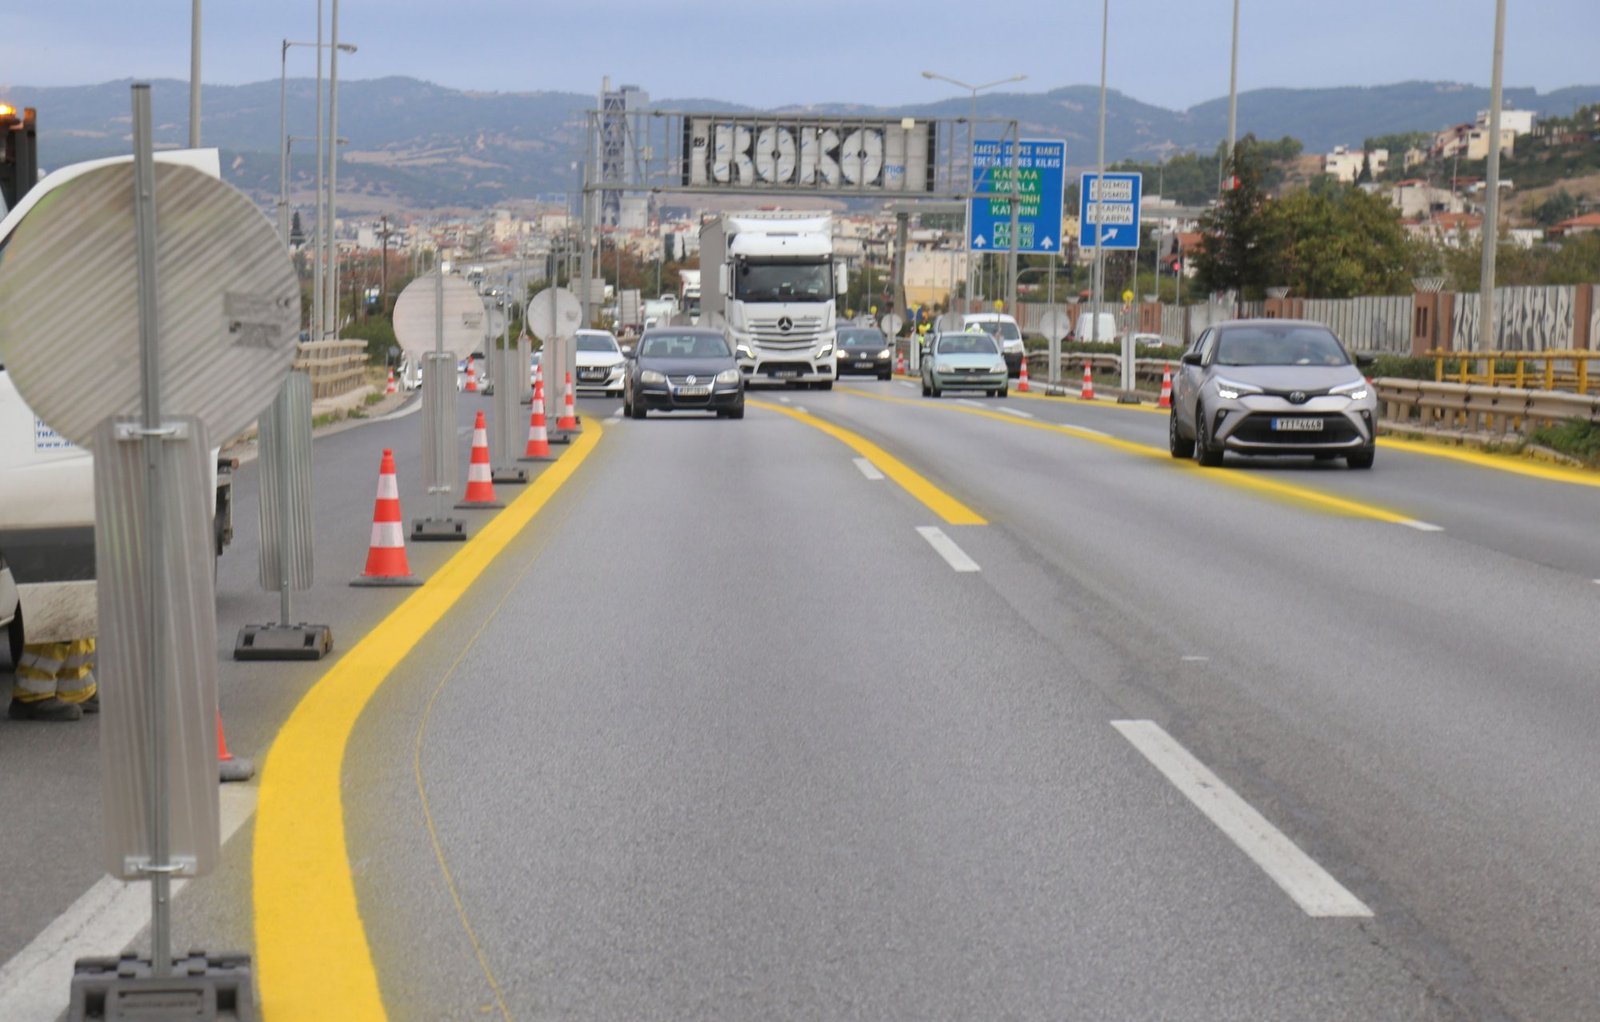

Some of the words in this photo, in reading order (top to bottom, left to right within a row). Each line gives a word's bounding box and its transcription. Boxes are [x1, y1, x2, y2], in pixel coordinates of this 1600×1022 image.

[1036, 158, 1060, 168] KILKIS
[1091, 181, 1130, 189] ΕΟΣΜΟΣ
[1091, 191, 1130, 199] EOSMOS
[992, 205, 1038, 216] KATRINI
